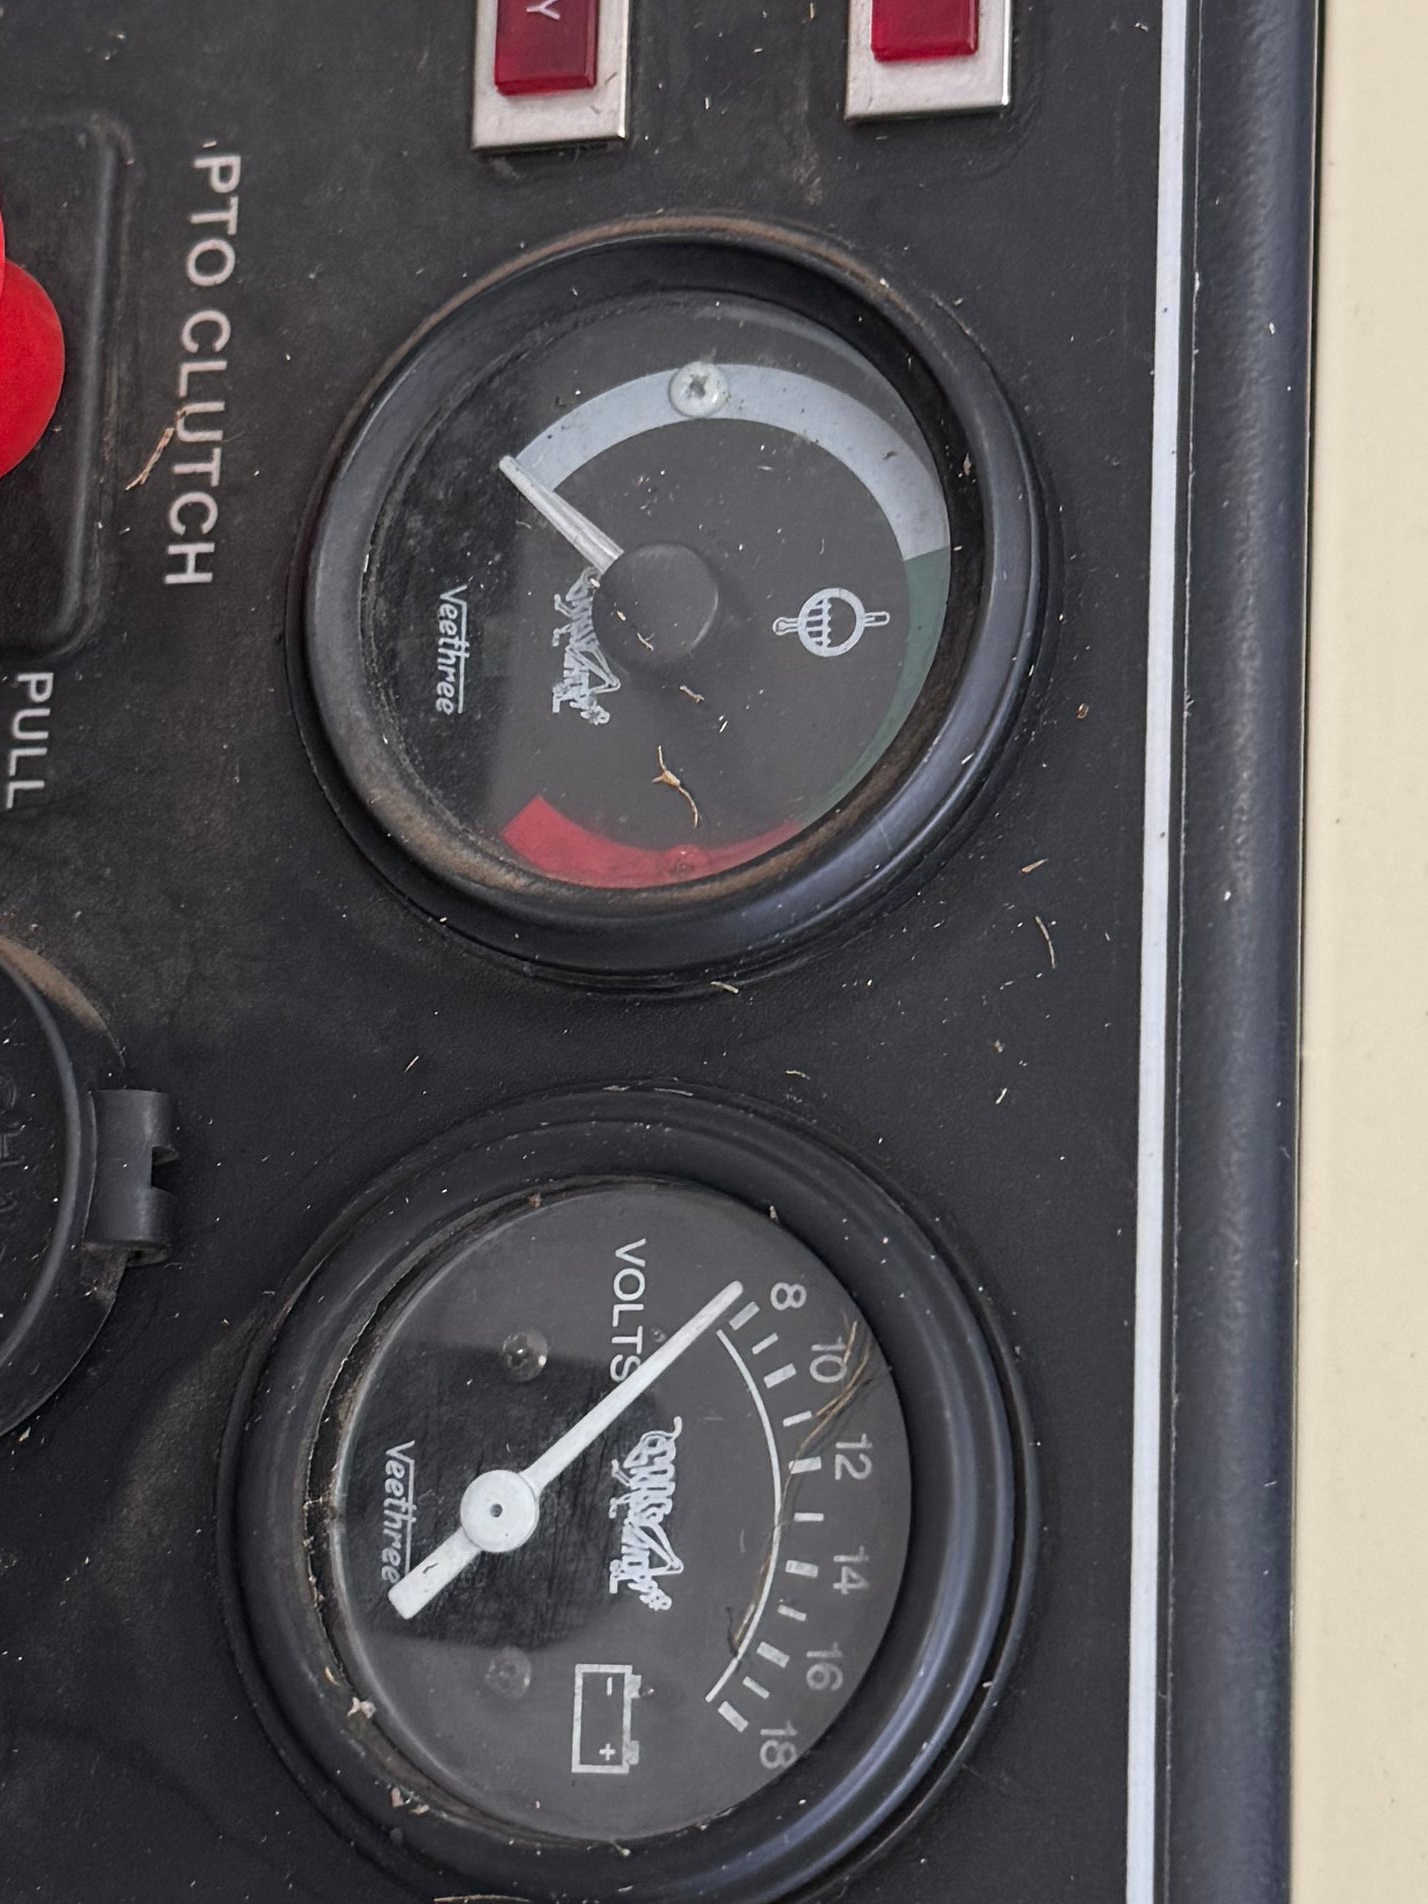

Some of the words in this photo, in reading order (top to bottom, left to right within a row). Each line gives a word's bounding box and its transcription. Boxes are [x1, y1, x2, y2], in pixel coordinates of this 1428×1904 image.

[186, 153, 242, 287] PTO
[165, 310, 233, 586] CLUTCH
[435, 585, 470, 715] Veethree
[4, 671, 56, 809] PULL
[609, 1237, 647, 1385] VOLTS
[770, 1282, 807, 1310] 8
[809, 1338, 848, 1385] 10
[834, 1434, 873, 1481] 12
[381, 1439, 416, 1582] Veethree
[833, 1546, 871, 1594] 14
[805, 1642, 845, 1691] 16
[759, 1721, 799, 1770] 18
